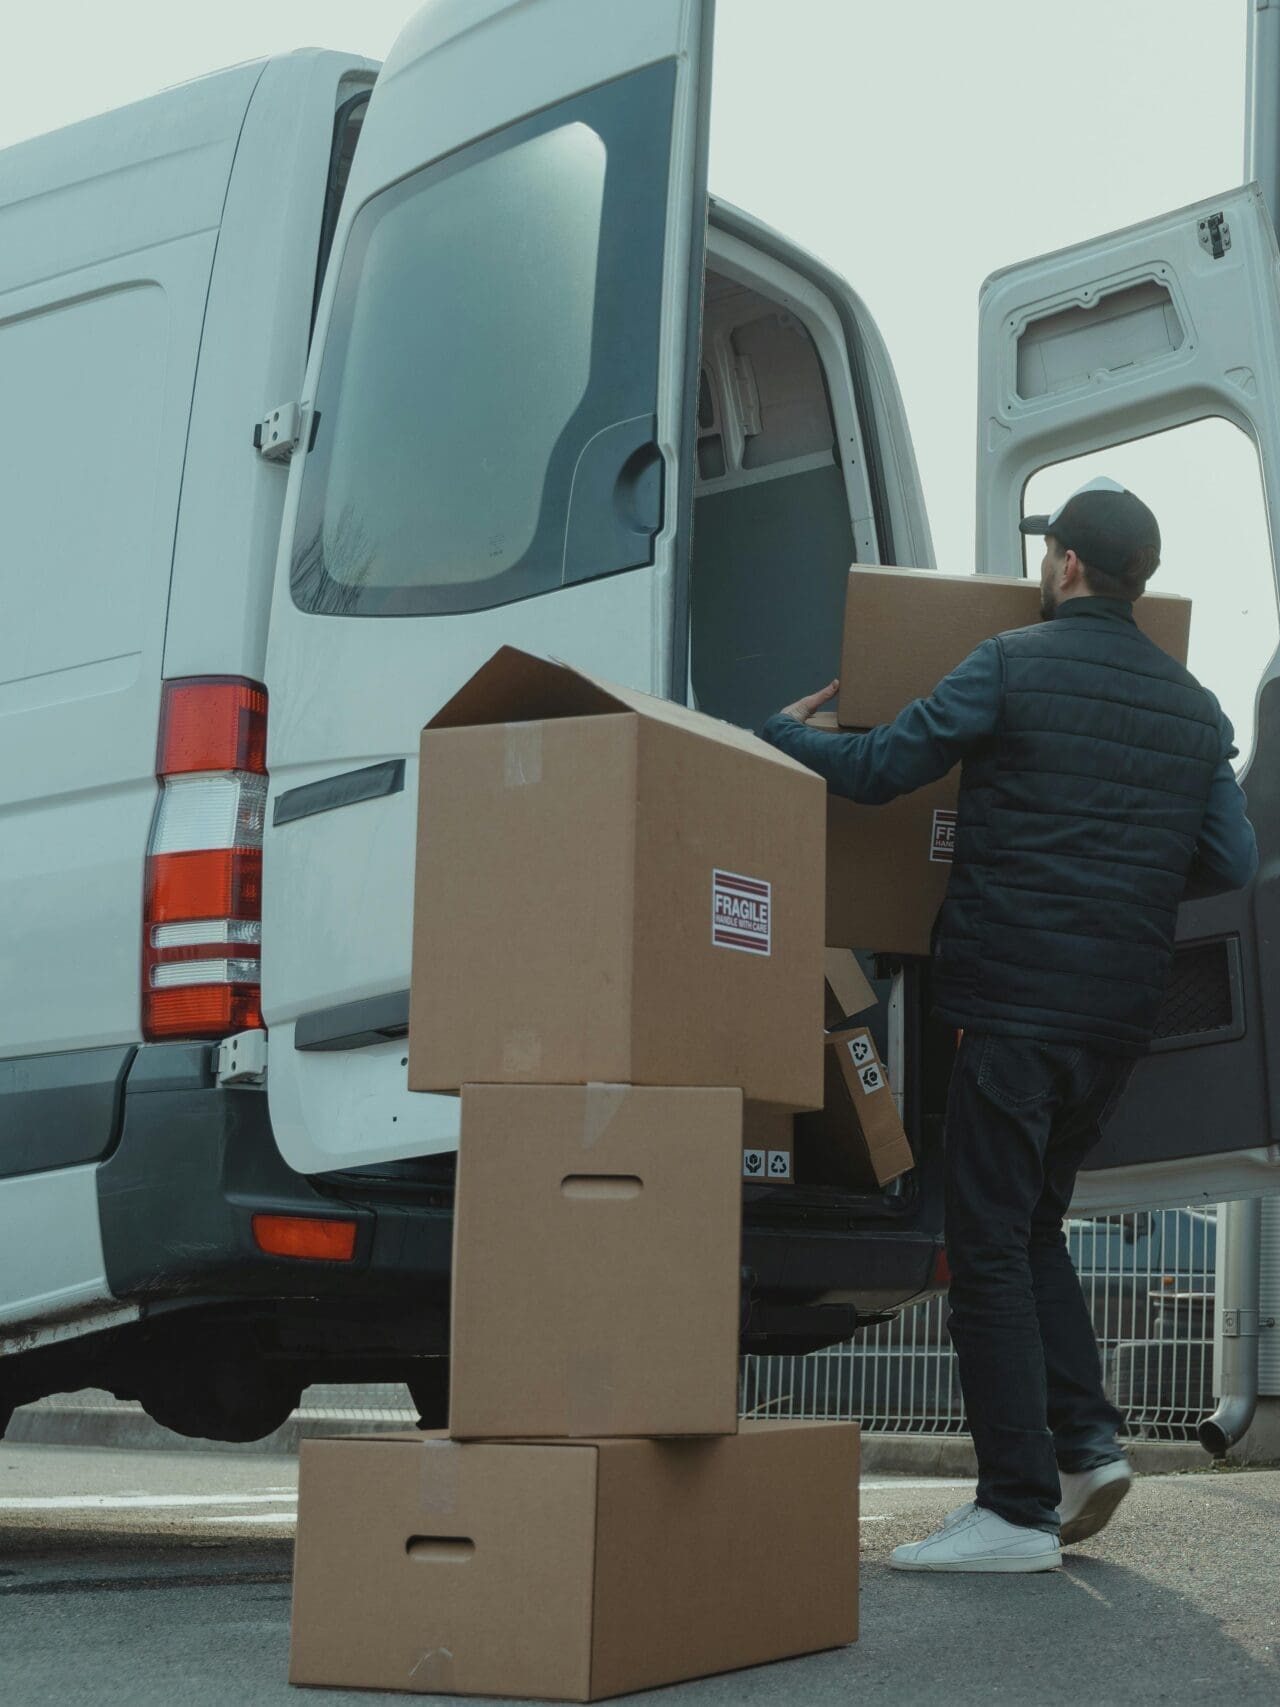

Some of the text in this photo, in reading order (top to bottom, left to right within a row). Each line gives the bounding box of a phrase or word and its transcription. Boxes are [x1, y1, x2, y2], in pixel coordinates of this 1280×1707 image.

[715, 894, 768, 923] FRAGILE
[715, 914, 768, 933] HANDLE WITH CARE
